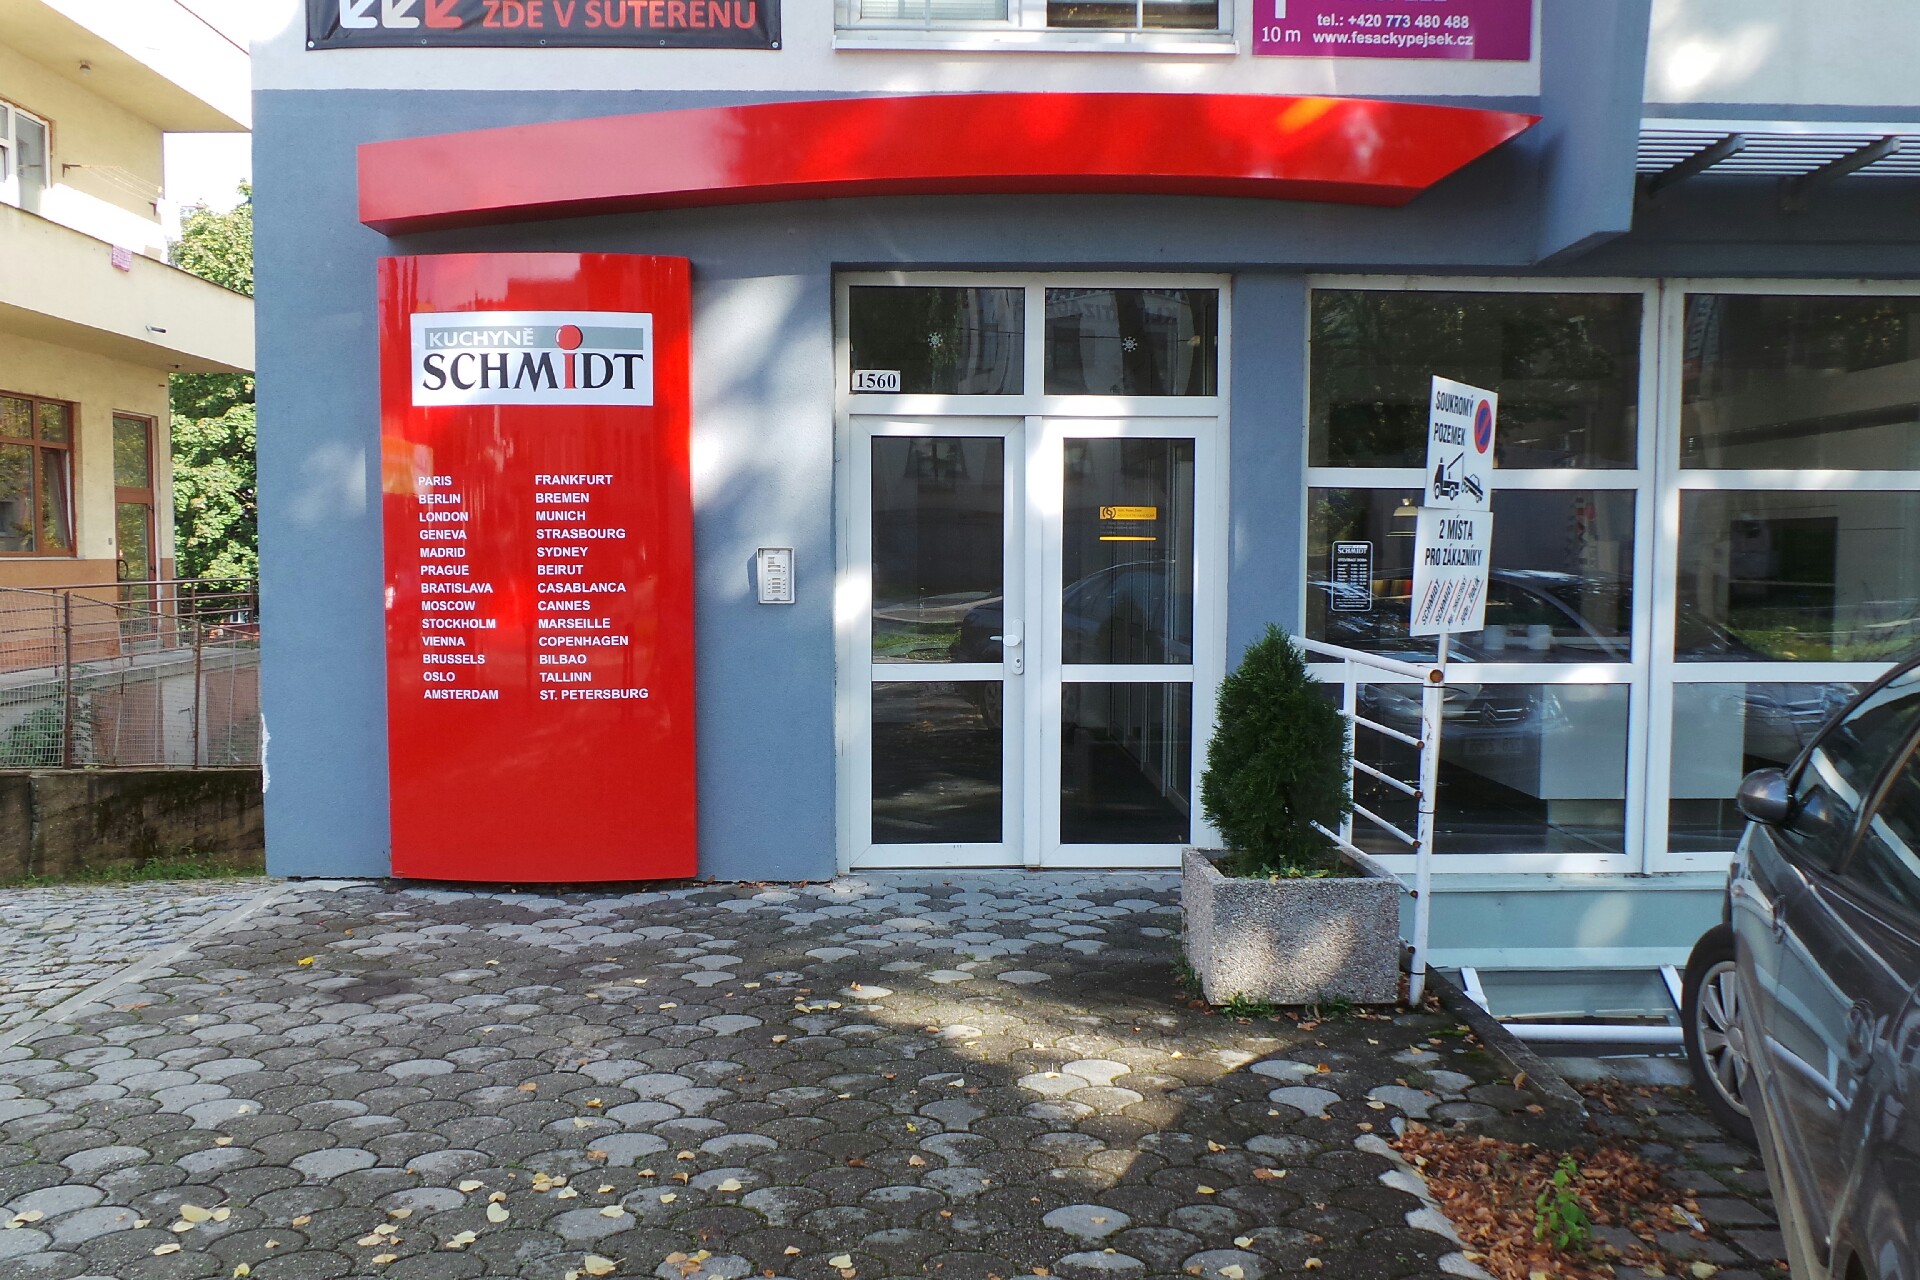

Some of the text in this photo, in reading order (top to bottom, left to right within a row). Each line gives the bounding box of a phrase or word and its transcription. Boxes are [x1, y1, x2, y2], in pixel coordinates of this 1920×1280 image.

[482, 0, 544, 28] ZDE
[552, 0, 576, 28] V
[1316, 13, 1470, 29] tel.: +420 773 480 488
[1261, 26, 1302, 43] 10 m
[1312, 31, 1474, 48] www.fesackypejsek.cz
[429, 327, 534, 348] KUCHYNĚ
[857, 373, 897, 389] 1560
[1435, 390, 1474, 418] SOUKROMÝ
[1433, 422, 1467, 447] POZEMEK
[418, 476, 452, 486] PARIS
[535, 474, 613, 485] FRANKFURT
[418, 494, 461, 504] BERLIN
[535, 493, 590, 503] BREMEN
[419, 511, 469, 522] LONDON
[536, 511, 586, 521] MUNICH
[1439, 514, 1473, 541] 2 MÍSTA
[419, 529, 467, 540] GENEVA
[536, 528, 626, 539] STRASBOURG
[420, 547, 466, 558] MADRID
[536, 547, 589, 557] SYDNEY
[1424, 543, 1483, 567] PRO ZÁKAZNÍKY
[420, 565, 470, 576] PRAGUE
[537, 564, 584, 575] BEIRUT
[421, 582, 494, 594] BRATISLAVA
[537, 582, 627, 593] CASABLANCA
[421, 600, 476, 611] MOSCOW
[538, 600, 591, 611] CANNES
[1421, 578, 1440, 625] SCHMIDT
[1435, 579, 1454, 625] SCHMIDT
[422, 618, 496, 629] STOCKHOLM
[538, 618, 611, 629] MARSEILLE
[422, 636, 466, 647] VIENNA
[539, 636, 629, 647] COPENHAGEN
[422, 654, 486, 665] BRUSSELS
[539, 654, 587, 665] BILBAO
[423, 672, 456, 682] OSLO
[539, 672, 592, 683] TALLINN
[424, 689, 499, 700] AMSTERDAM
[539, 687, 649, 700] ST. PETERSBURG
